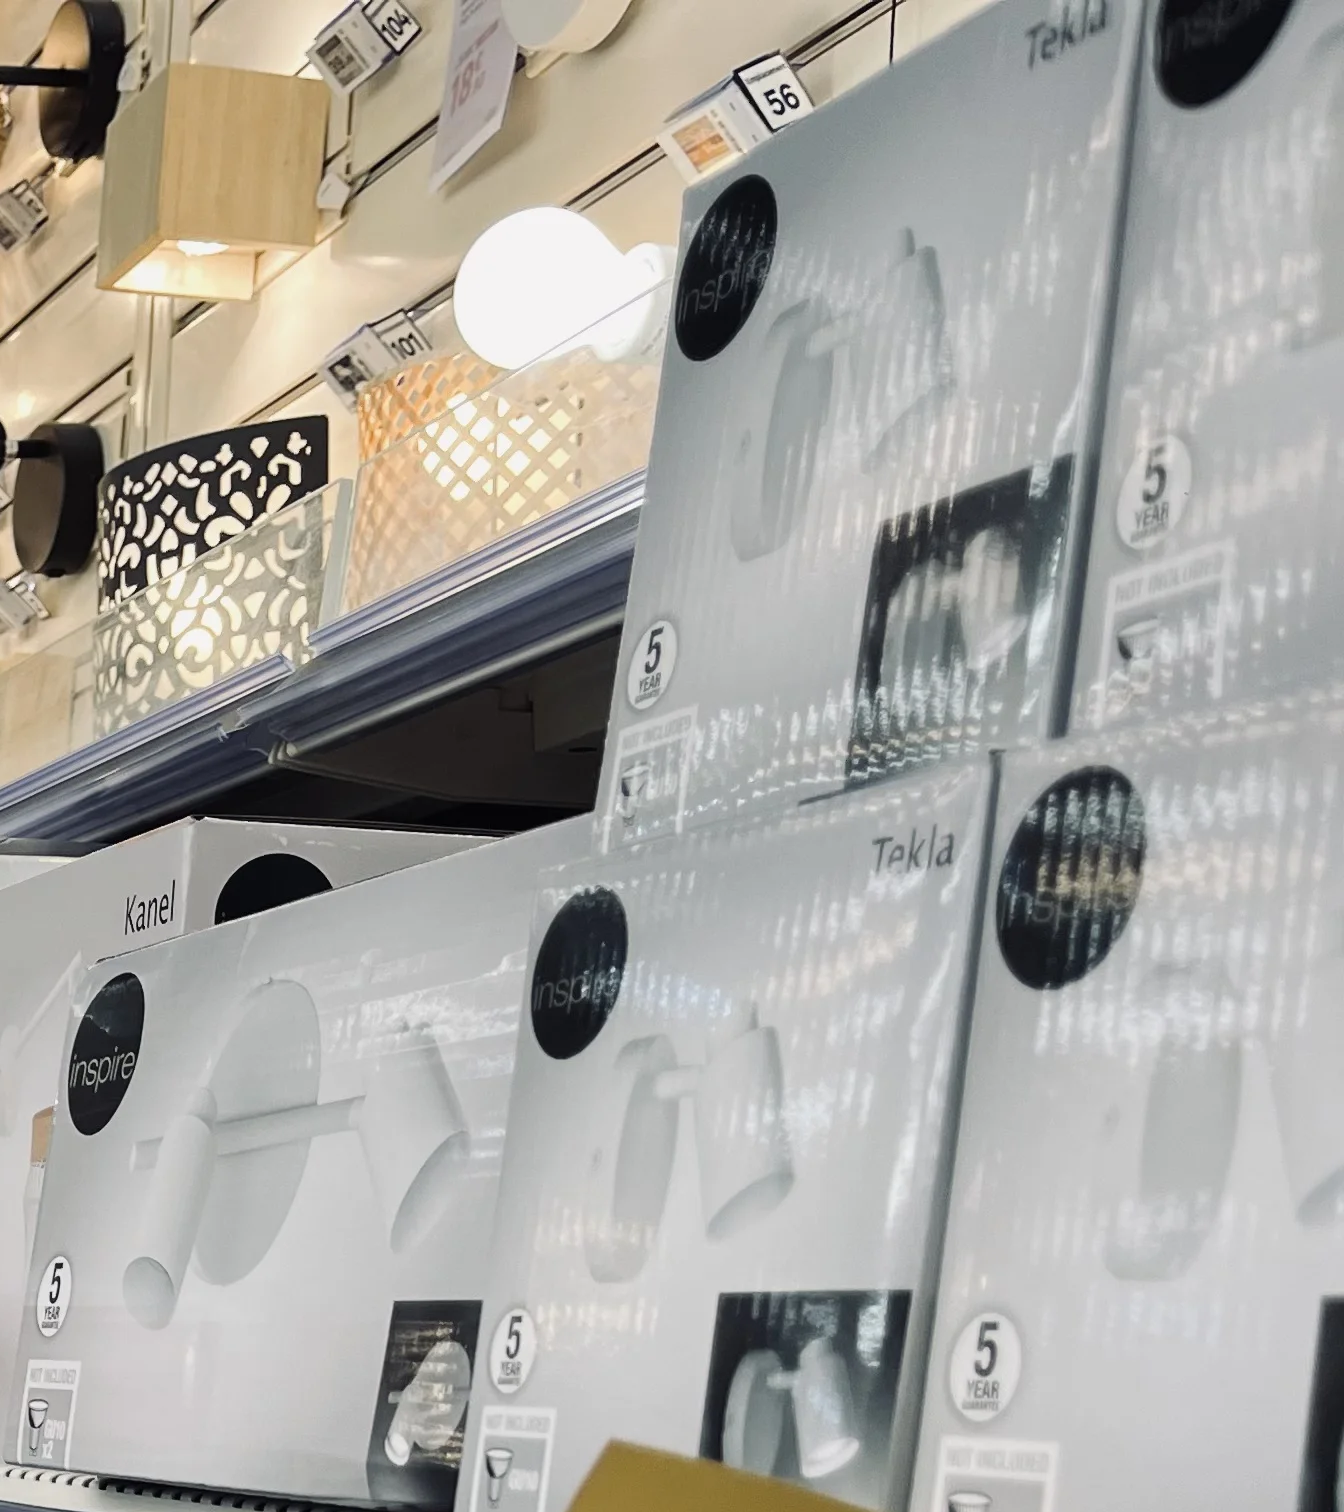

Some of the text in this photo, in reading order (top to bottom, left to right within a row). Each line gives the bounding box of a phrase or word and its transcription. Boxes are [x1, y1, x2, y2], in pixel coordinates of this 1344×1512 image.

[380, 9, 412, 42] 104
[763, 83, 800, 116] 56
[391, 332, 424, 360] 101
[1141, 444, 1167, 504] 5
[644, 626, 664, 675] 5
[638, 671, 662, 694] YEAR
[872, 822, 955, 877] Tekla
[124, 879, 176, 936] Kanel
[69, 1045, 136, 1094] inspire
[49, 1262, 64, 1305] 5
[43, 1305, 61, 1321] YEAR
[505, 1315, 523, 1360] 5
[974, 1321, 1000, 1377] 5
[500, 1361, 521, 1377] YEAR
[966, 1379, 1000, 1400] YEAR
